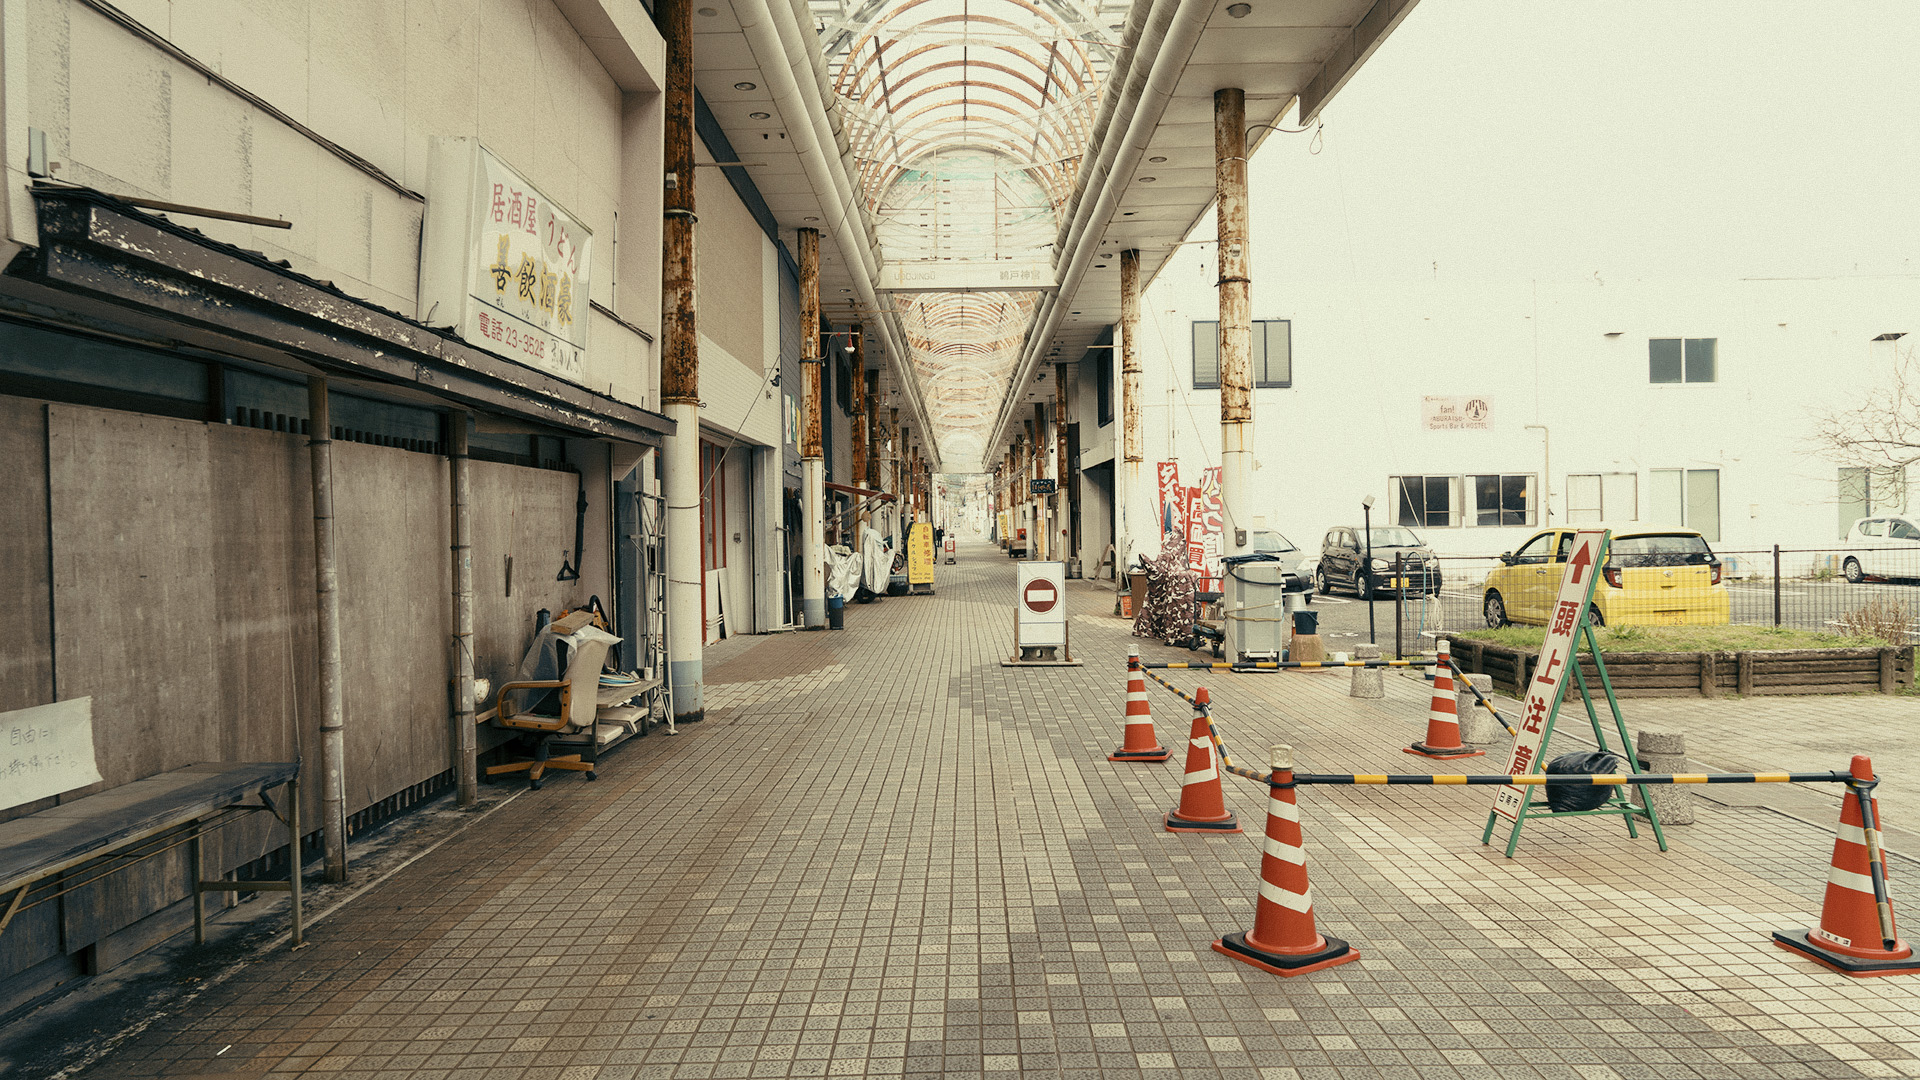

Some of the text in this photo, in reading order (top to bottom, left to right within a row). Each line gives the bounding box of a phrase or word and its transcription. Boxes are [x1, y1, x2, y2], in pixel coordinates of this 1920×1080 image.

[490, 182, 578, 275] 居酒屋 うどん
[478, 311, 505, 342] 電話
[1429, 423, 1448, 431] Sports
[1466, 422, 1488, 430] HOSTEL
[1508, 600, 1579, 776] 頭上注意
[0, 724, 49, 747] 自由に
